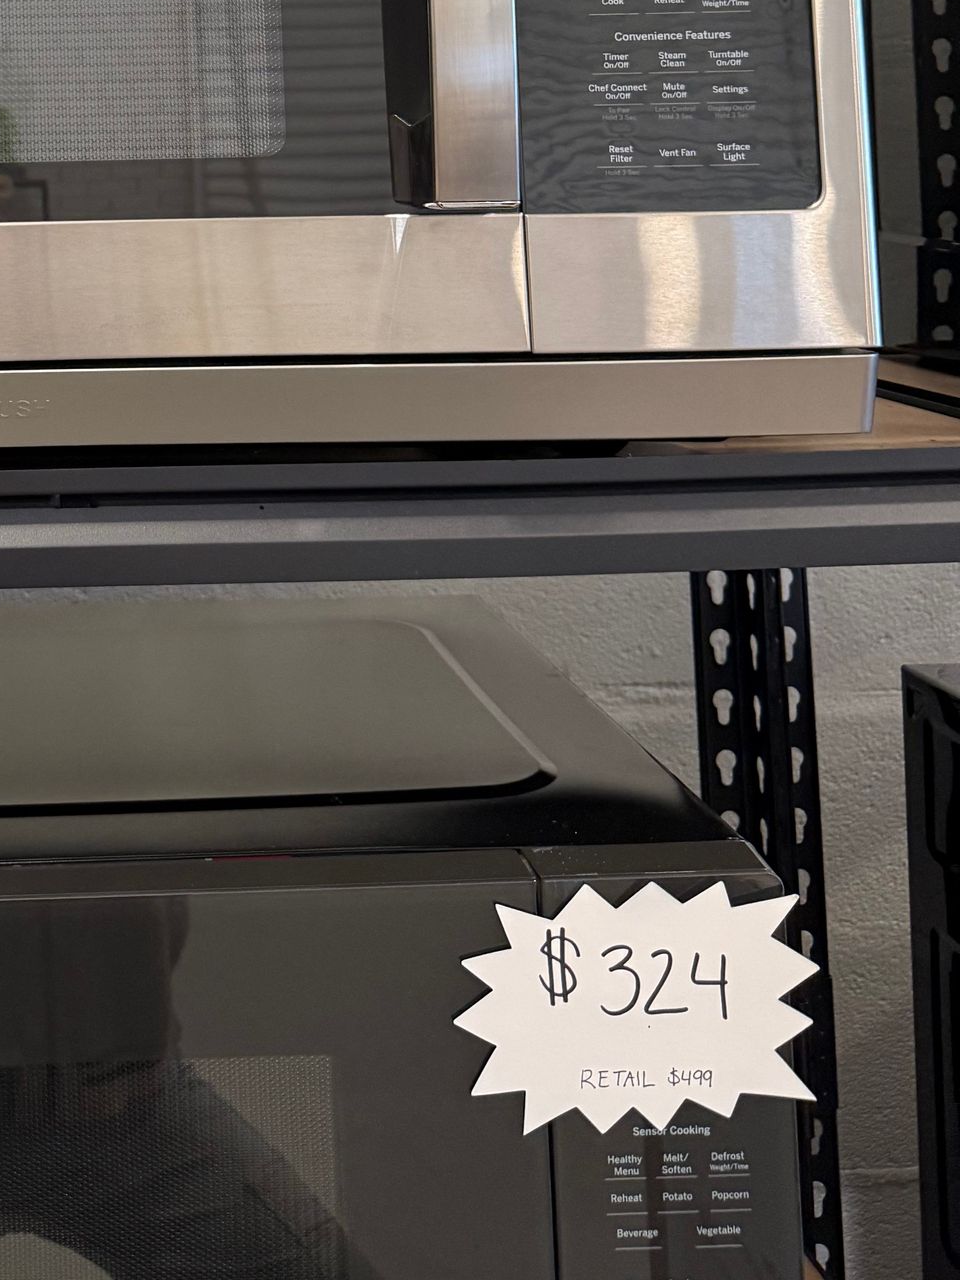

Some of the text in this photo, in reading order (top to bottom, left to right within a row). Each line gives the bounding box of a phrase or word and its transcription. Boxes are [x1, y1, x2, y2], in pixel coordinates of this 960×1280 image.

[701, 0, 750, 8] Weight/Time
[614, 30, 732, 42] Convenience Features
[603, 53, 629, 61] Timer
[658, 51, 687, 60] Steam
[708, 50, 749, 59] Turntable
[603, 61, 630, 69] On/Off
[660, 59, 685, 68] Clean
[715, 59, 742, 67] On/Off
[588, 83, 647, 93] Chef Connect
[662, 82, 685, 91] Mute
[712, 84, 749, 95] Settings
[605, 92, 631, 100] On/Off
[661, 91, 688, 99] On/Off
[608, 145, 633, 153] Reset
[717, 143, 751, 152] Surface
[659, 149, 696, 157] Vent Fan
[723, 152, 746, 162] Light
[610, 154, 633, 163] Filter
[539, 927, 729, 1020] $324
[580, 1067, 713, 1089] RETAIL $499
[632, 1125, 711, 1136] Sensor Cooking
[607, 1154, 643, 1165] Healthy
[663, 1153, 689, 1162] Melt/
[711, 1151, 745, 1161] Defrost
[614, 1167, 640, 1176] Menu
[662, 1165, 692, 1174] Soften
[610, 1193, 643, 1203] Reheat
[662, 1192, 693, 1201] Potato
[711, 1190, 750, 1201] Popcorn
[616, 1228, 659, 1238] Beverage
[696, 1225, 741, 1237] Vegetable
